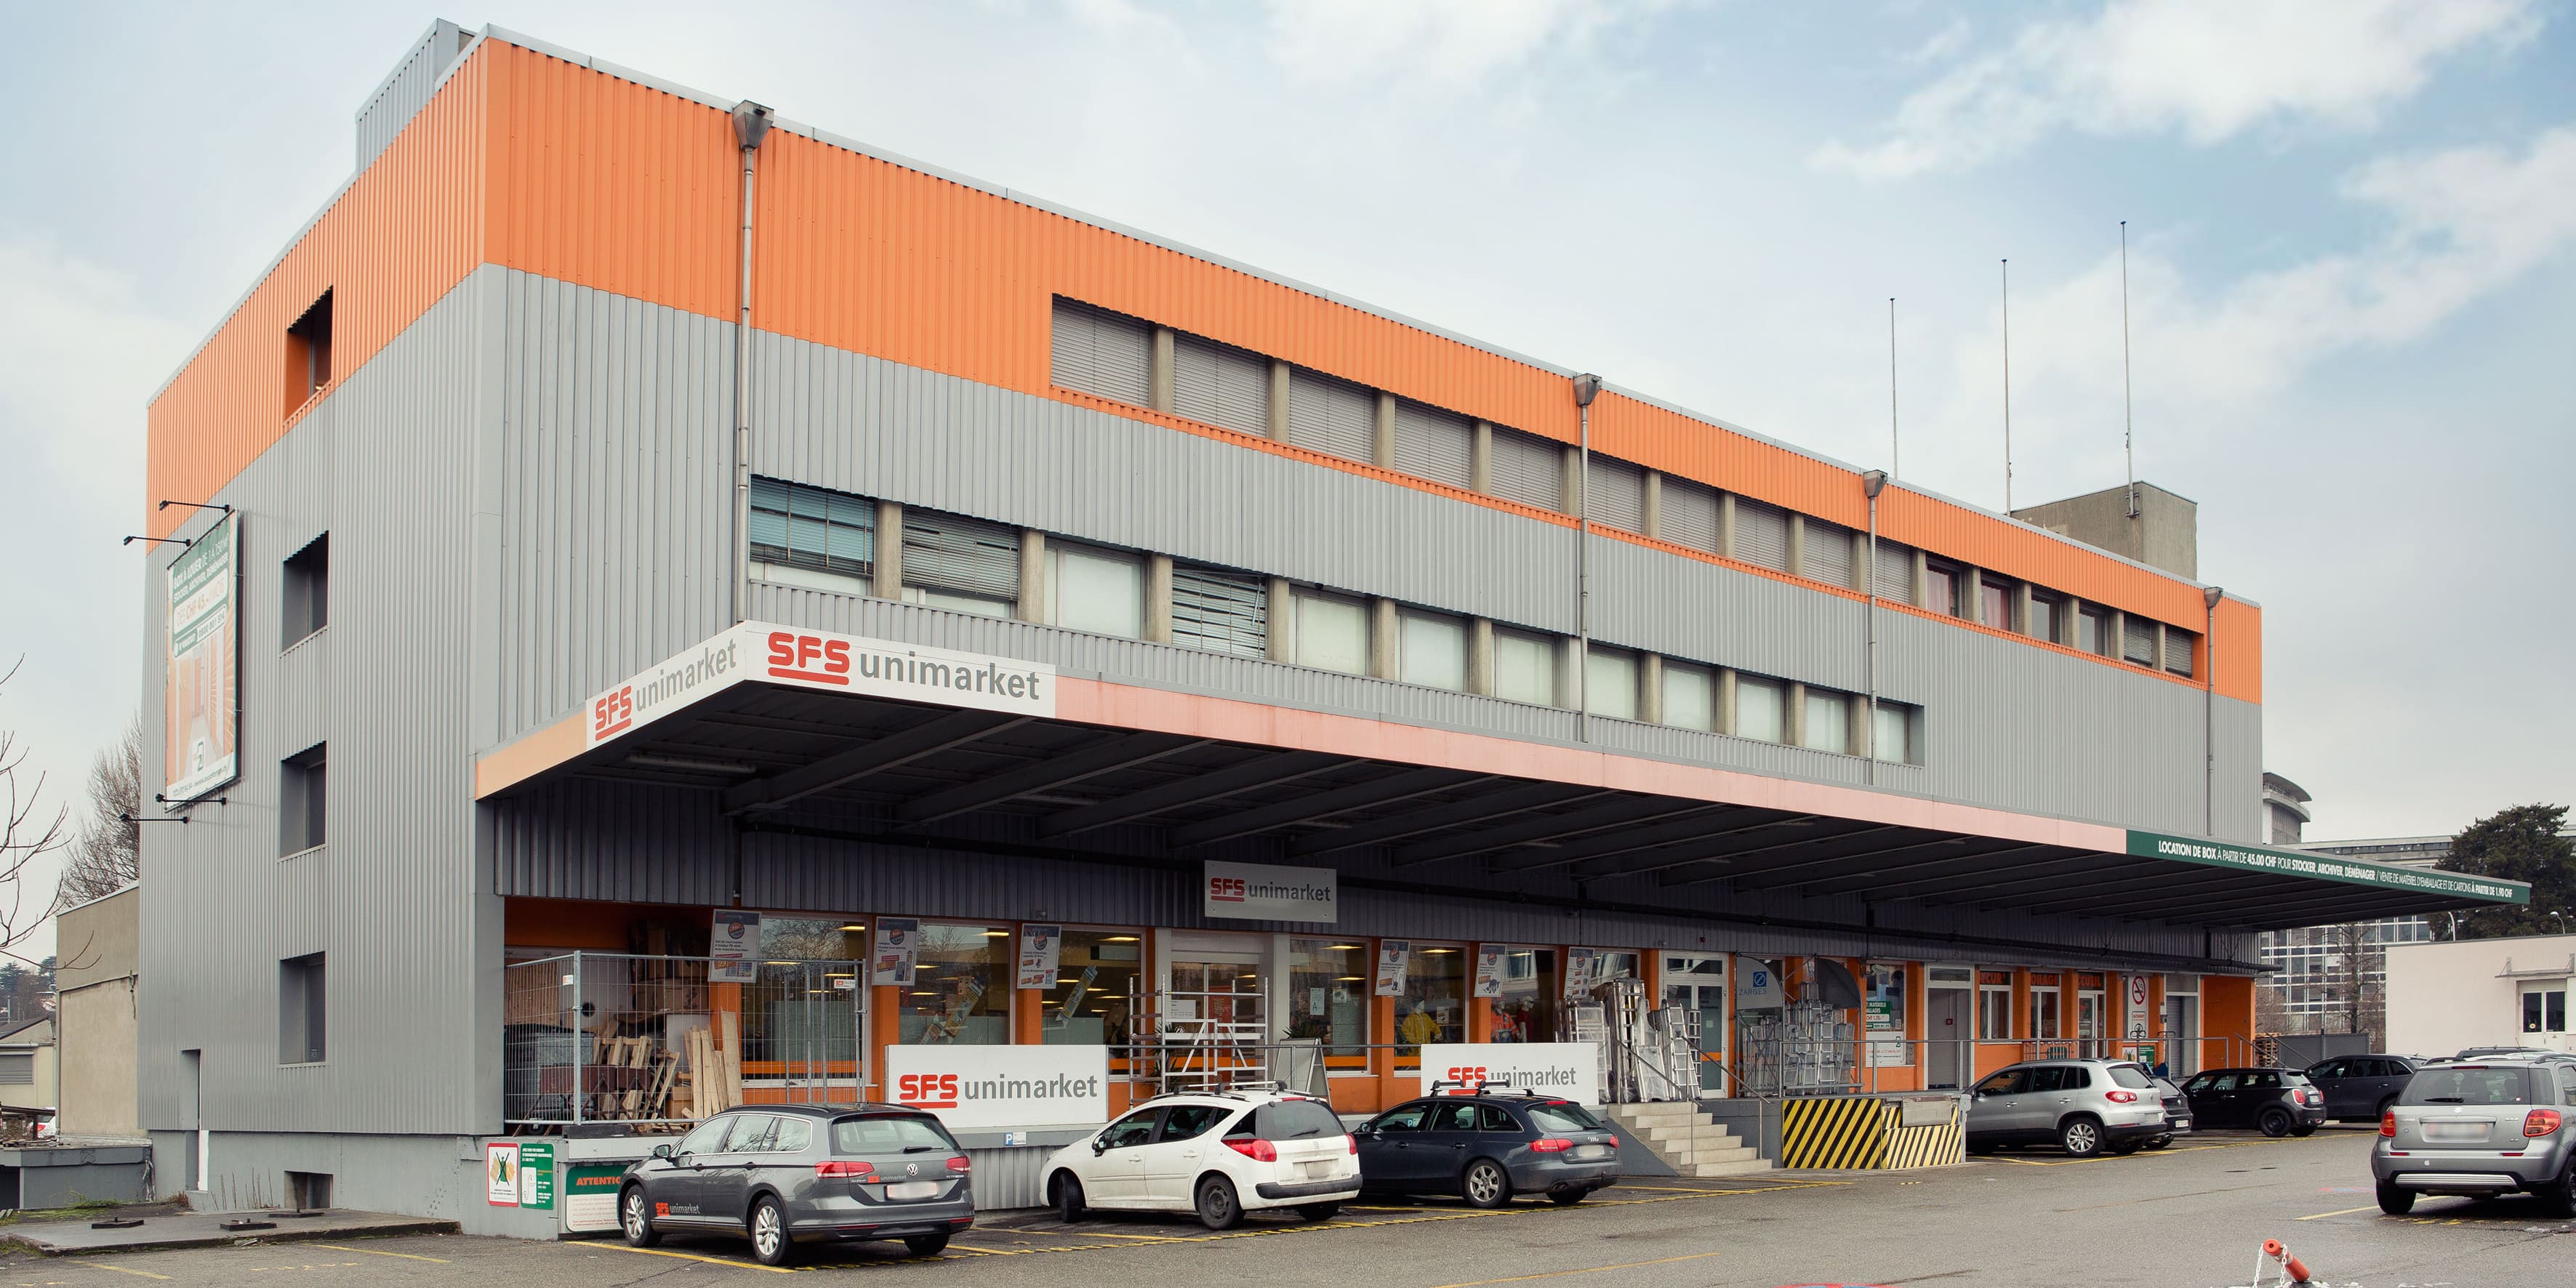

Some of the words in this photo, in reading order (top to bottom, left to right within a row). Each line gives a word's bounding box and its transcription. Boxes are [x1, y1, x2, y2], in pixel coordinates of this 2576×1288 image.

[768, 632, 850, 673] SFS
[860, 651, 1039, 700] unimarket
[595, 685, 632, 731] SFS
[636, 638, 737, 712] unimarket
[2158, 840, 2192, 857] LOCATION
[2192, 845, 2202, 858] DE
[2202, 846, 2217, 861] BOX
[2217, 845, 2223, 861] À
[2222, 849, 2239, 863] PARTIR
[2239, 852, 2247, 864] DE
[2247, 853, 2265, 866] 45.00
[2265, 856, 2277, 867] CHF
[2277, 857, 2292, 870] POUR
[2292, 859, 2317, 875] STOCKER,
[2317, 862, 2344, 878] ARCHIVER,
[2345, 864, 2375, 881] DÉMÉNAGER
[2379, 871, 2393, 883] VENTE
[2393, 873, 2399, 884] DE
[1211, 877, 1245, 896] SFS
[1248, 882, 1331, 901] unimarket
[2031, 973, 2059, 986] ORAGE
[899, 1074, 958, 1100] SFS
[965, 1073, 1097, 1099] unimarket
[1448, 1066, 1487, 1087] SFS
[1490, 1065, 1576, 1086] unimarket
[1006, 1134, 1013, 1145] P
[576, 1175, 622, 1186] ATTENTIO
[655, 1202, 669, 1213] SFS
[669, 1203, 701, 1215] unimarket
